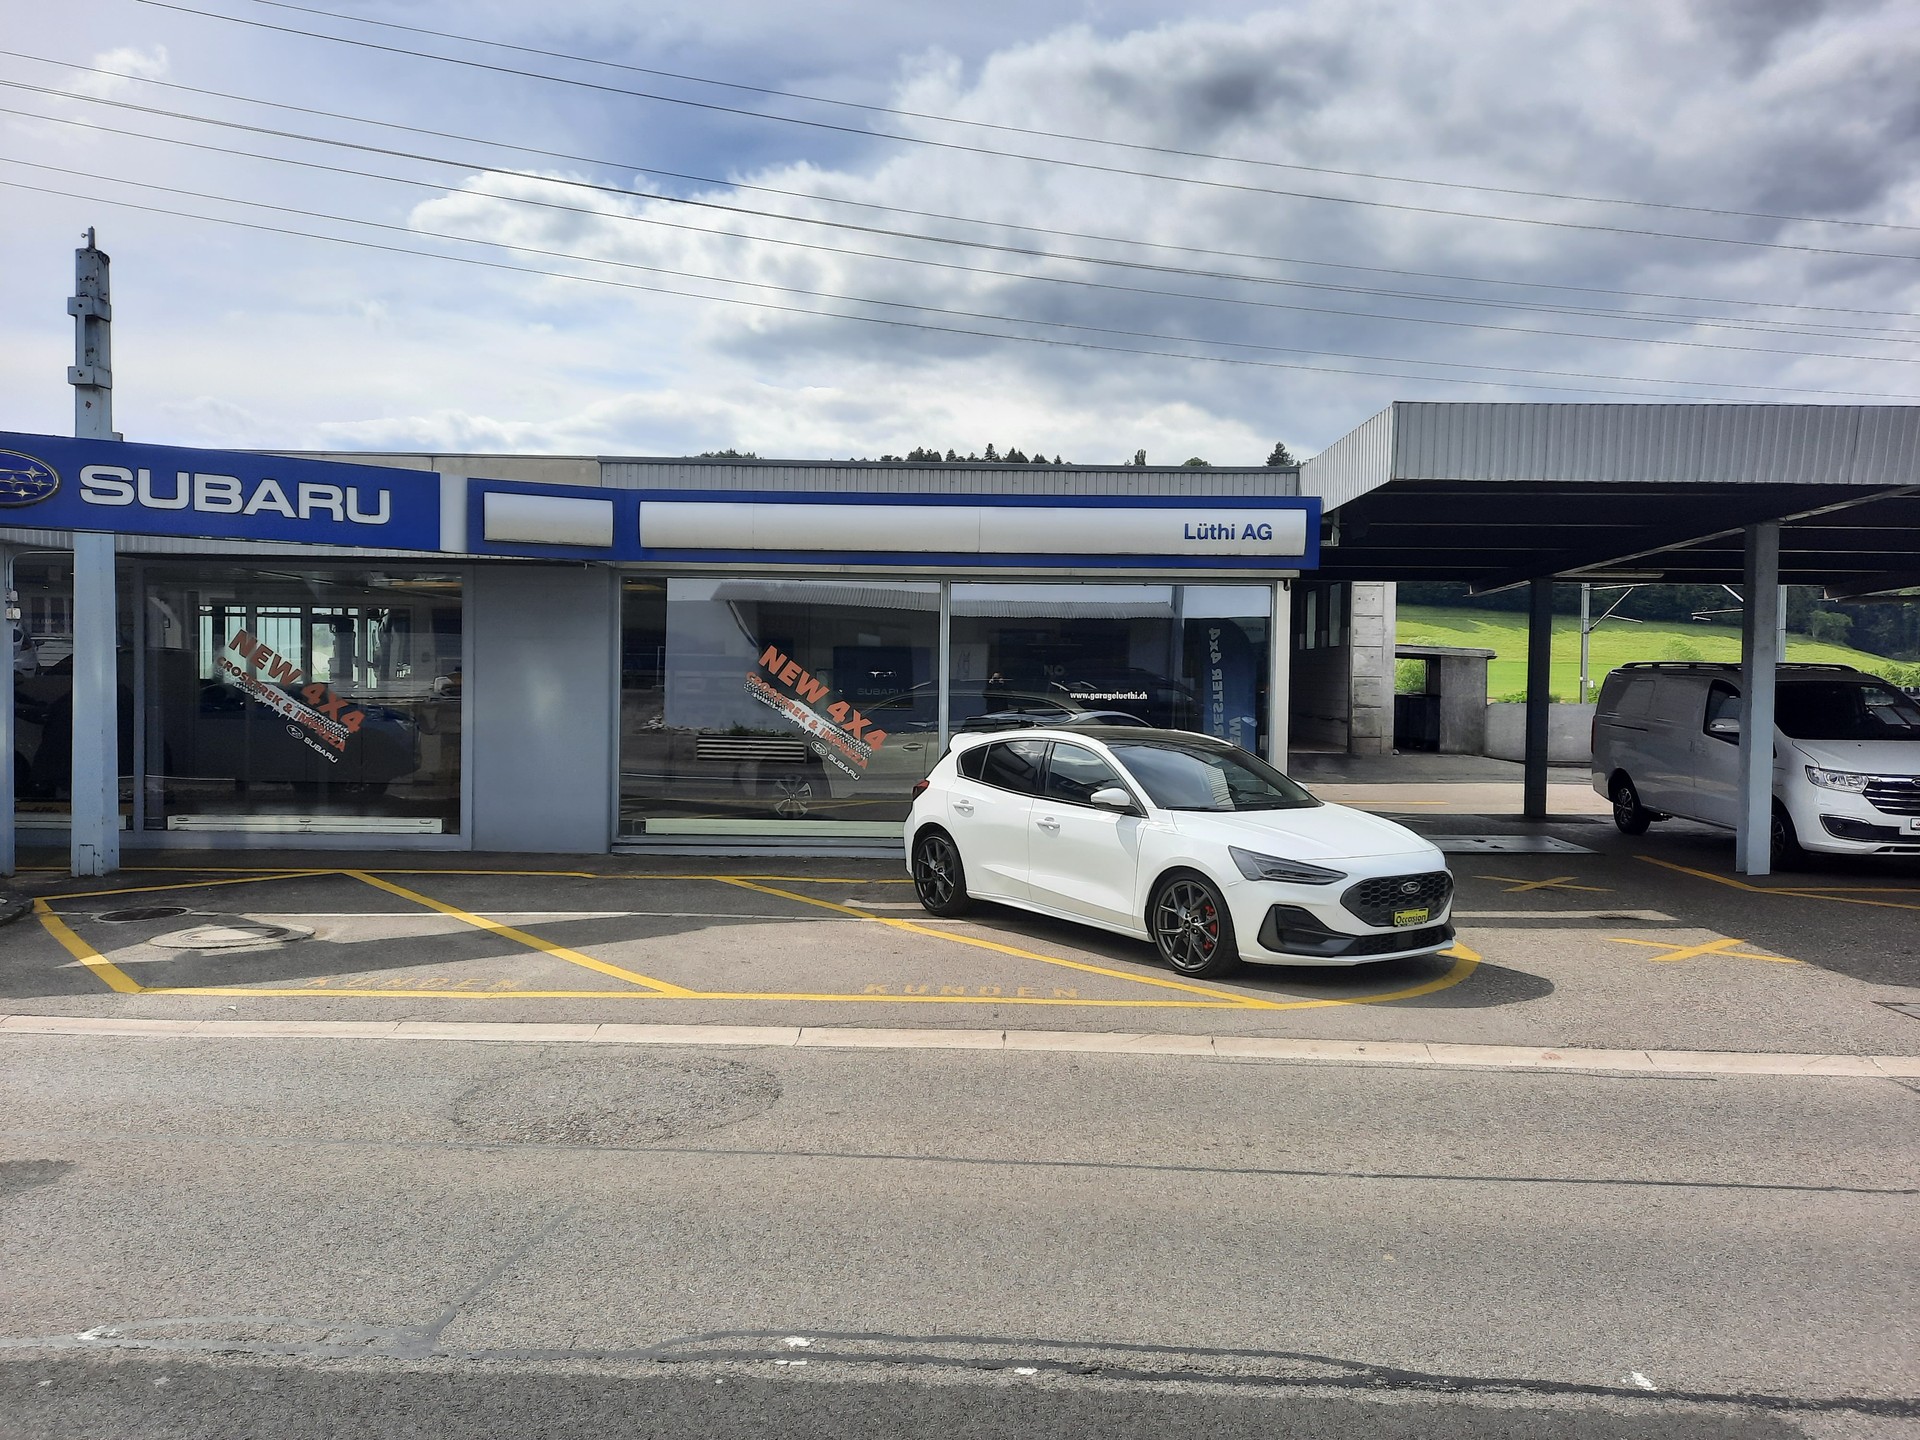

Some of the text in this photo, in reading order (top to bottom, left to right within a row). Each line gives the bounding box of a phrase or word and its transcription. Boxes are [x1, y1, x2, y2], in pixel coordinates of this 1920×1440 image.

[79, 464, 391, 525] SUBARU
[1184, 523, 1273, 540] Lüthi AG
[228, 628, 365, 734] NEW 4X4
[758, 644, 887, 751] NEW 4X4
[282, 702, 294, 716] &
[293, 710, 347, 752] IMPREZA
[808, 719, 819, 731] &
[818, 727, 869, 769] IMPREZA
[303, 736, 339, 764] SUBARU
[827, 753, 861, 781] SUBARU
[1395, 913, 1427, 924] Occasion
[863, 983, 1078, 998] KUNDEN
